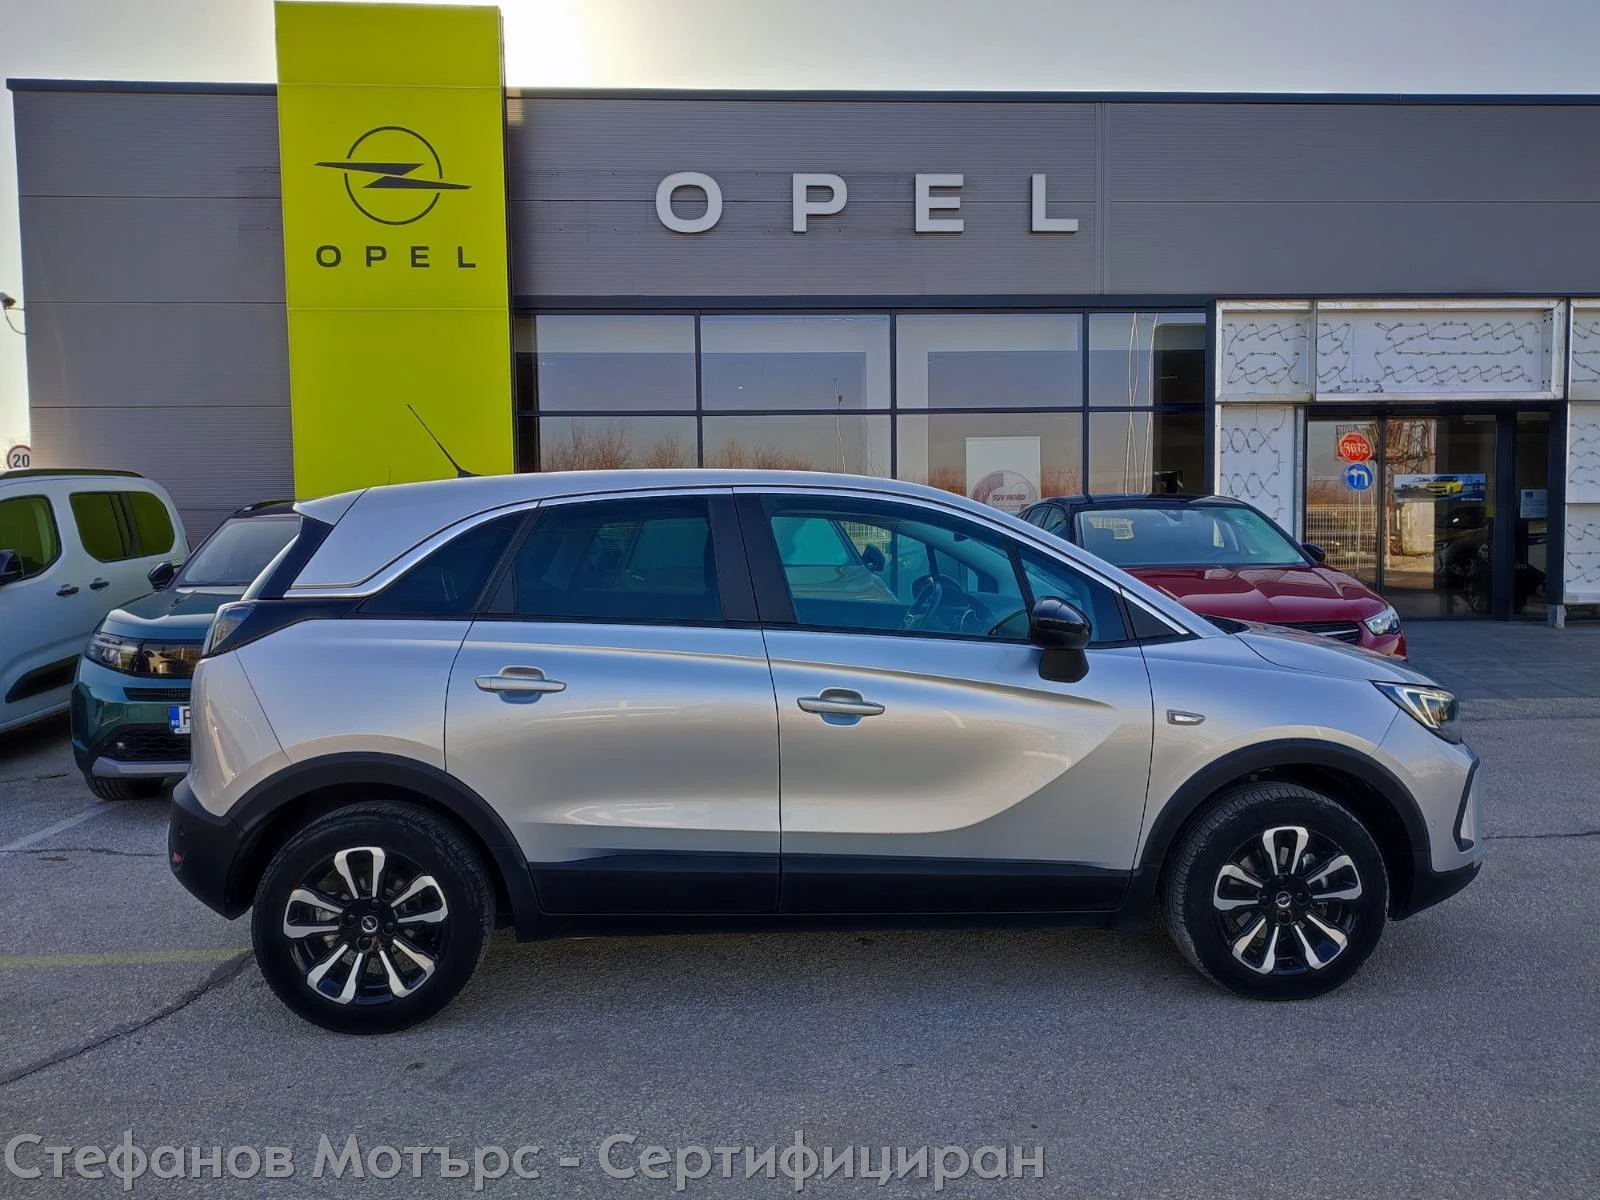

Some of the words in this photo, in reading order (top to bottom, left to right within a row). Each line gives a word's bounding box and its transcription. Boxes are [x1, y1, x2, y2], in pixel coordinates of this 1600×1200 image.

[654, 171, 1080, 234] OPEL
[315, 244, 477, 269] OPEL
[12, 453, 30, 468] 20
